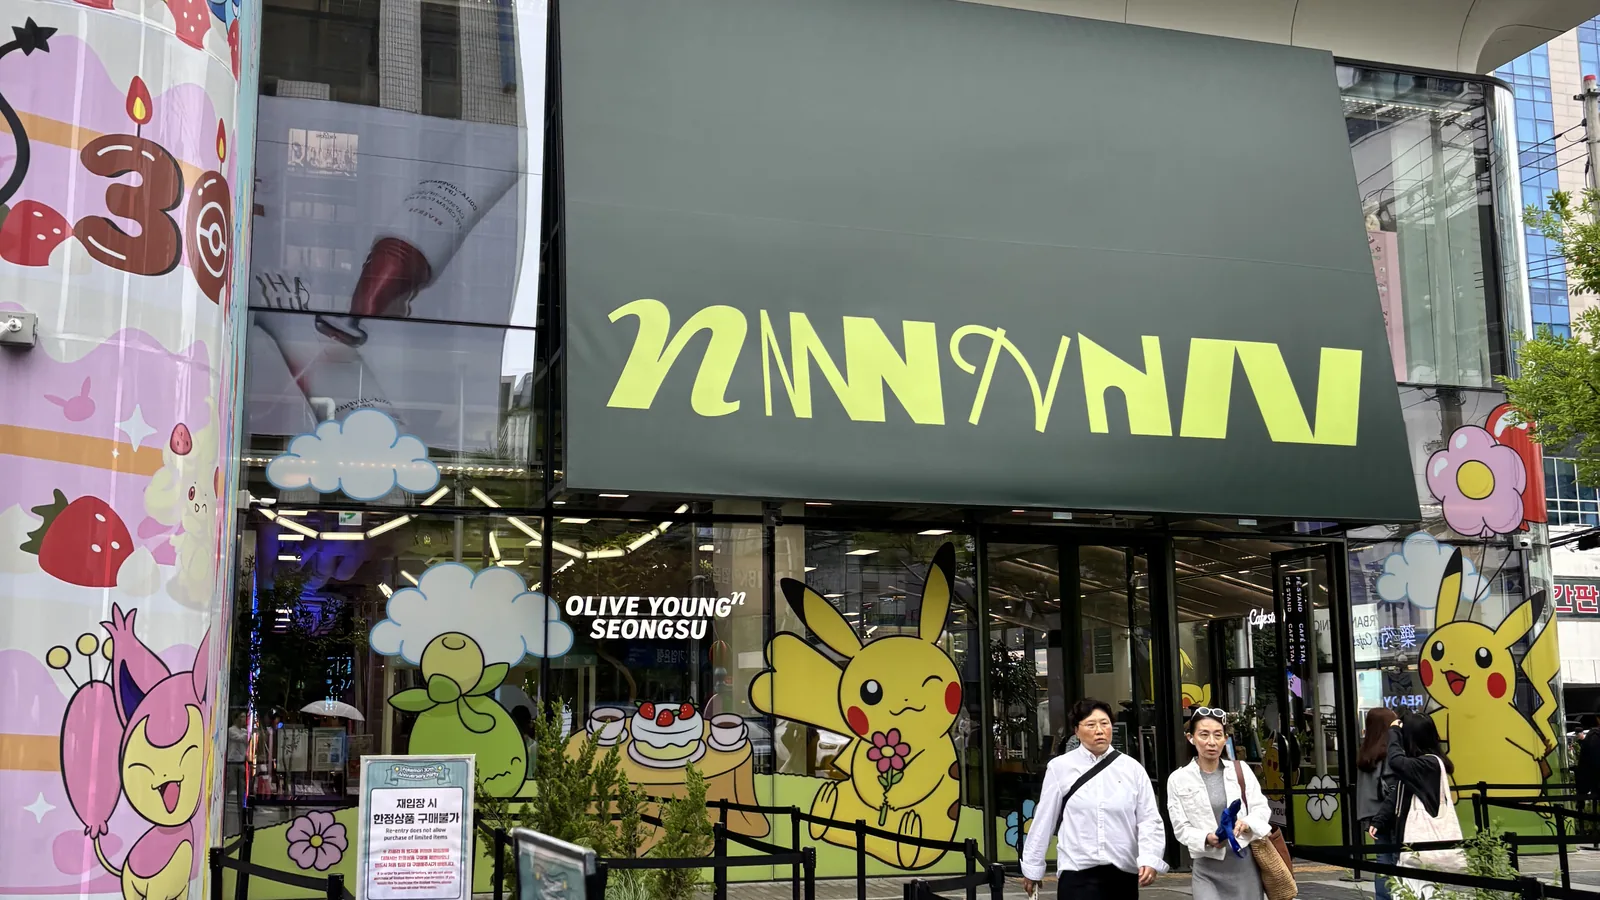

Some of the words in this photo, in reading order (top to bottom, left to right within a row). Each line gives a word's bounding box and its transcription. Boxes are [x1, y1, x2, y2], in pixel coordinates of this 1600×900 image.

[565, 595, 640, 616] OLIVE
[590, 618, 708, 640] SEONGSU
[396, 798, 425, 809] 재입장
[427, 798, 437, 809] 시
[373, 813, 415, 824] 한정상품
[417, 812, 460, 824] 구매불가
